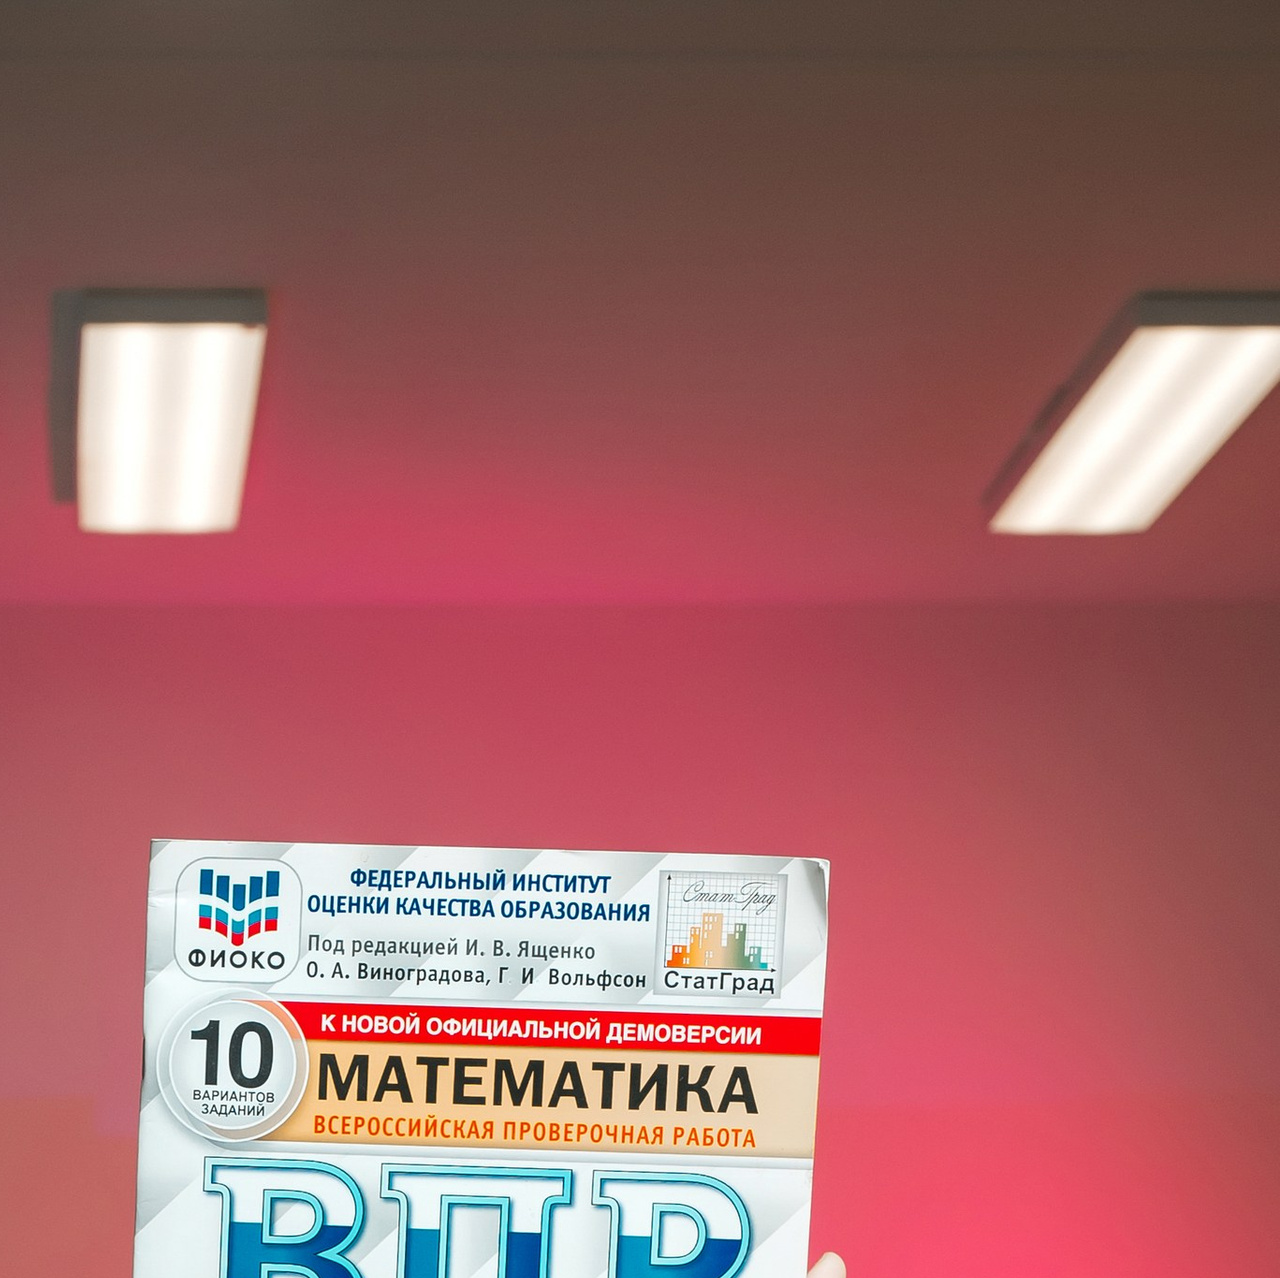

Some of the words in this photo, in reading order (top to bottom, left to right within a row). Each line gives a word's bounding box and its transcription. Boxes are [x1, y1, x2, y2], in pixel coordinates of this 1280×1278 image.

[349, 868, 506, 892] ФЕДЕРАЛЬНЫЙ
[512, 873, 612, 894] ИНСТИТУТ
[307, 894, 390, 917] ОЦЕНКИ
[395, 898, 496, 918] КАЧЕСТВА
[500, 901, 651, 923] ОБРАЗОВАНИЯ
[187, 948, 286, 971] ФИОКО
[308, 935, 346, 957] Под
[351, 937, 459, 960] редакцией
[465, 938, 486, 957] И.
[492, 940, 511, 958] В.
[517, 940, 596, 962] Ященко
[306, 960, 325, 979] О.
[331, 962, 350, 980] А.
[357, 963, 491, 986] Виноградова,
[548, 970, 647, 992] Вольфсон
[664, 970, 775, 995] СтатГрад
[320, 1014, 336, 1033] К
[341, 1012, 420, 1036] НОВОЙ
[425, 1016, 601, 1041] ОФИЦИАЛЬНОЙ
[605, 1022, 762, 1045] ДЕМОВЕРСИИ
[190, 1019, 275, 1089] 10
[192, 1089, 275, 1104] ВАРИАНТОВ
[317, 1052, 759, 1115] МАТЕМАТИКА
[201, 1102, 266, 1118] ЗАДАНИЙ
[313, 1114, 495, 1140] ВСЕРОССИЙСКАЯ
[503, 1121, 664, 1146] ПРОВЕРОЧНАЯ
[673, 1127, 756, 1148] РАБОТА
